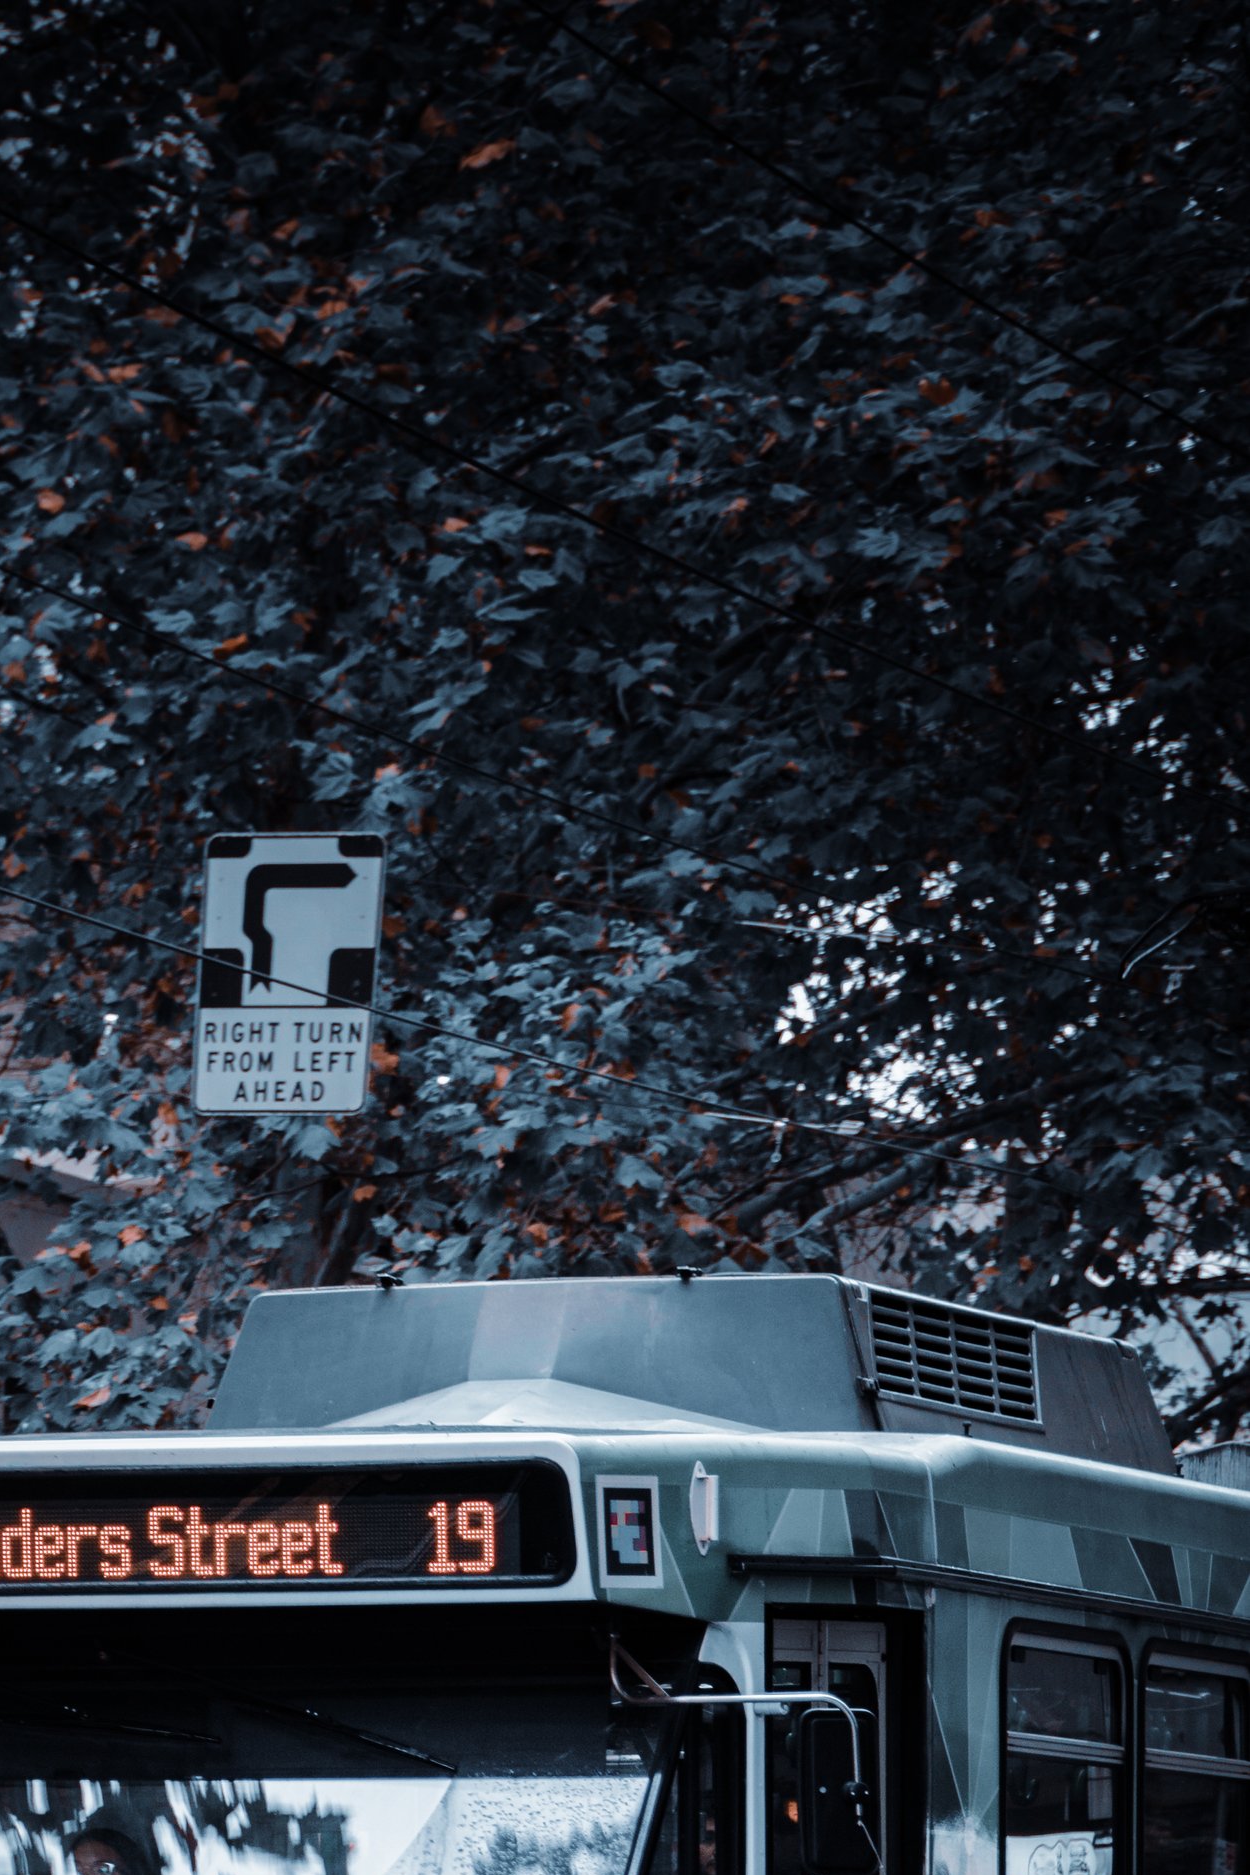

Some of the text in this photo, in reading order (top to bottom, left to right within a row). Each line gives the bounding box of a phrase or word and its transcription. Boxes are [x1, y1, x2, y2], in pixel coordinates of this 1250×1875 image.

[204, 1022, 363, 1043] RIGHT TURN
[207, 1051, 357, 1073] FROM LEFT
[234, 1081, 325, 1102] AHEAD
[146, 1503, 345, 1578] Street
[426, 1500, 497, 1575] 19
